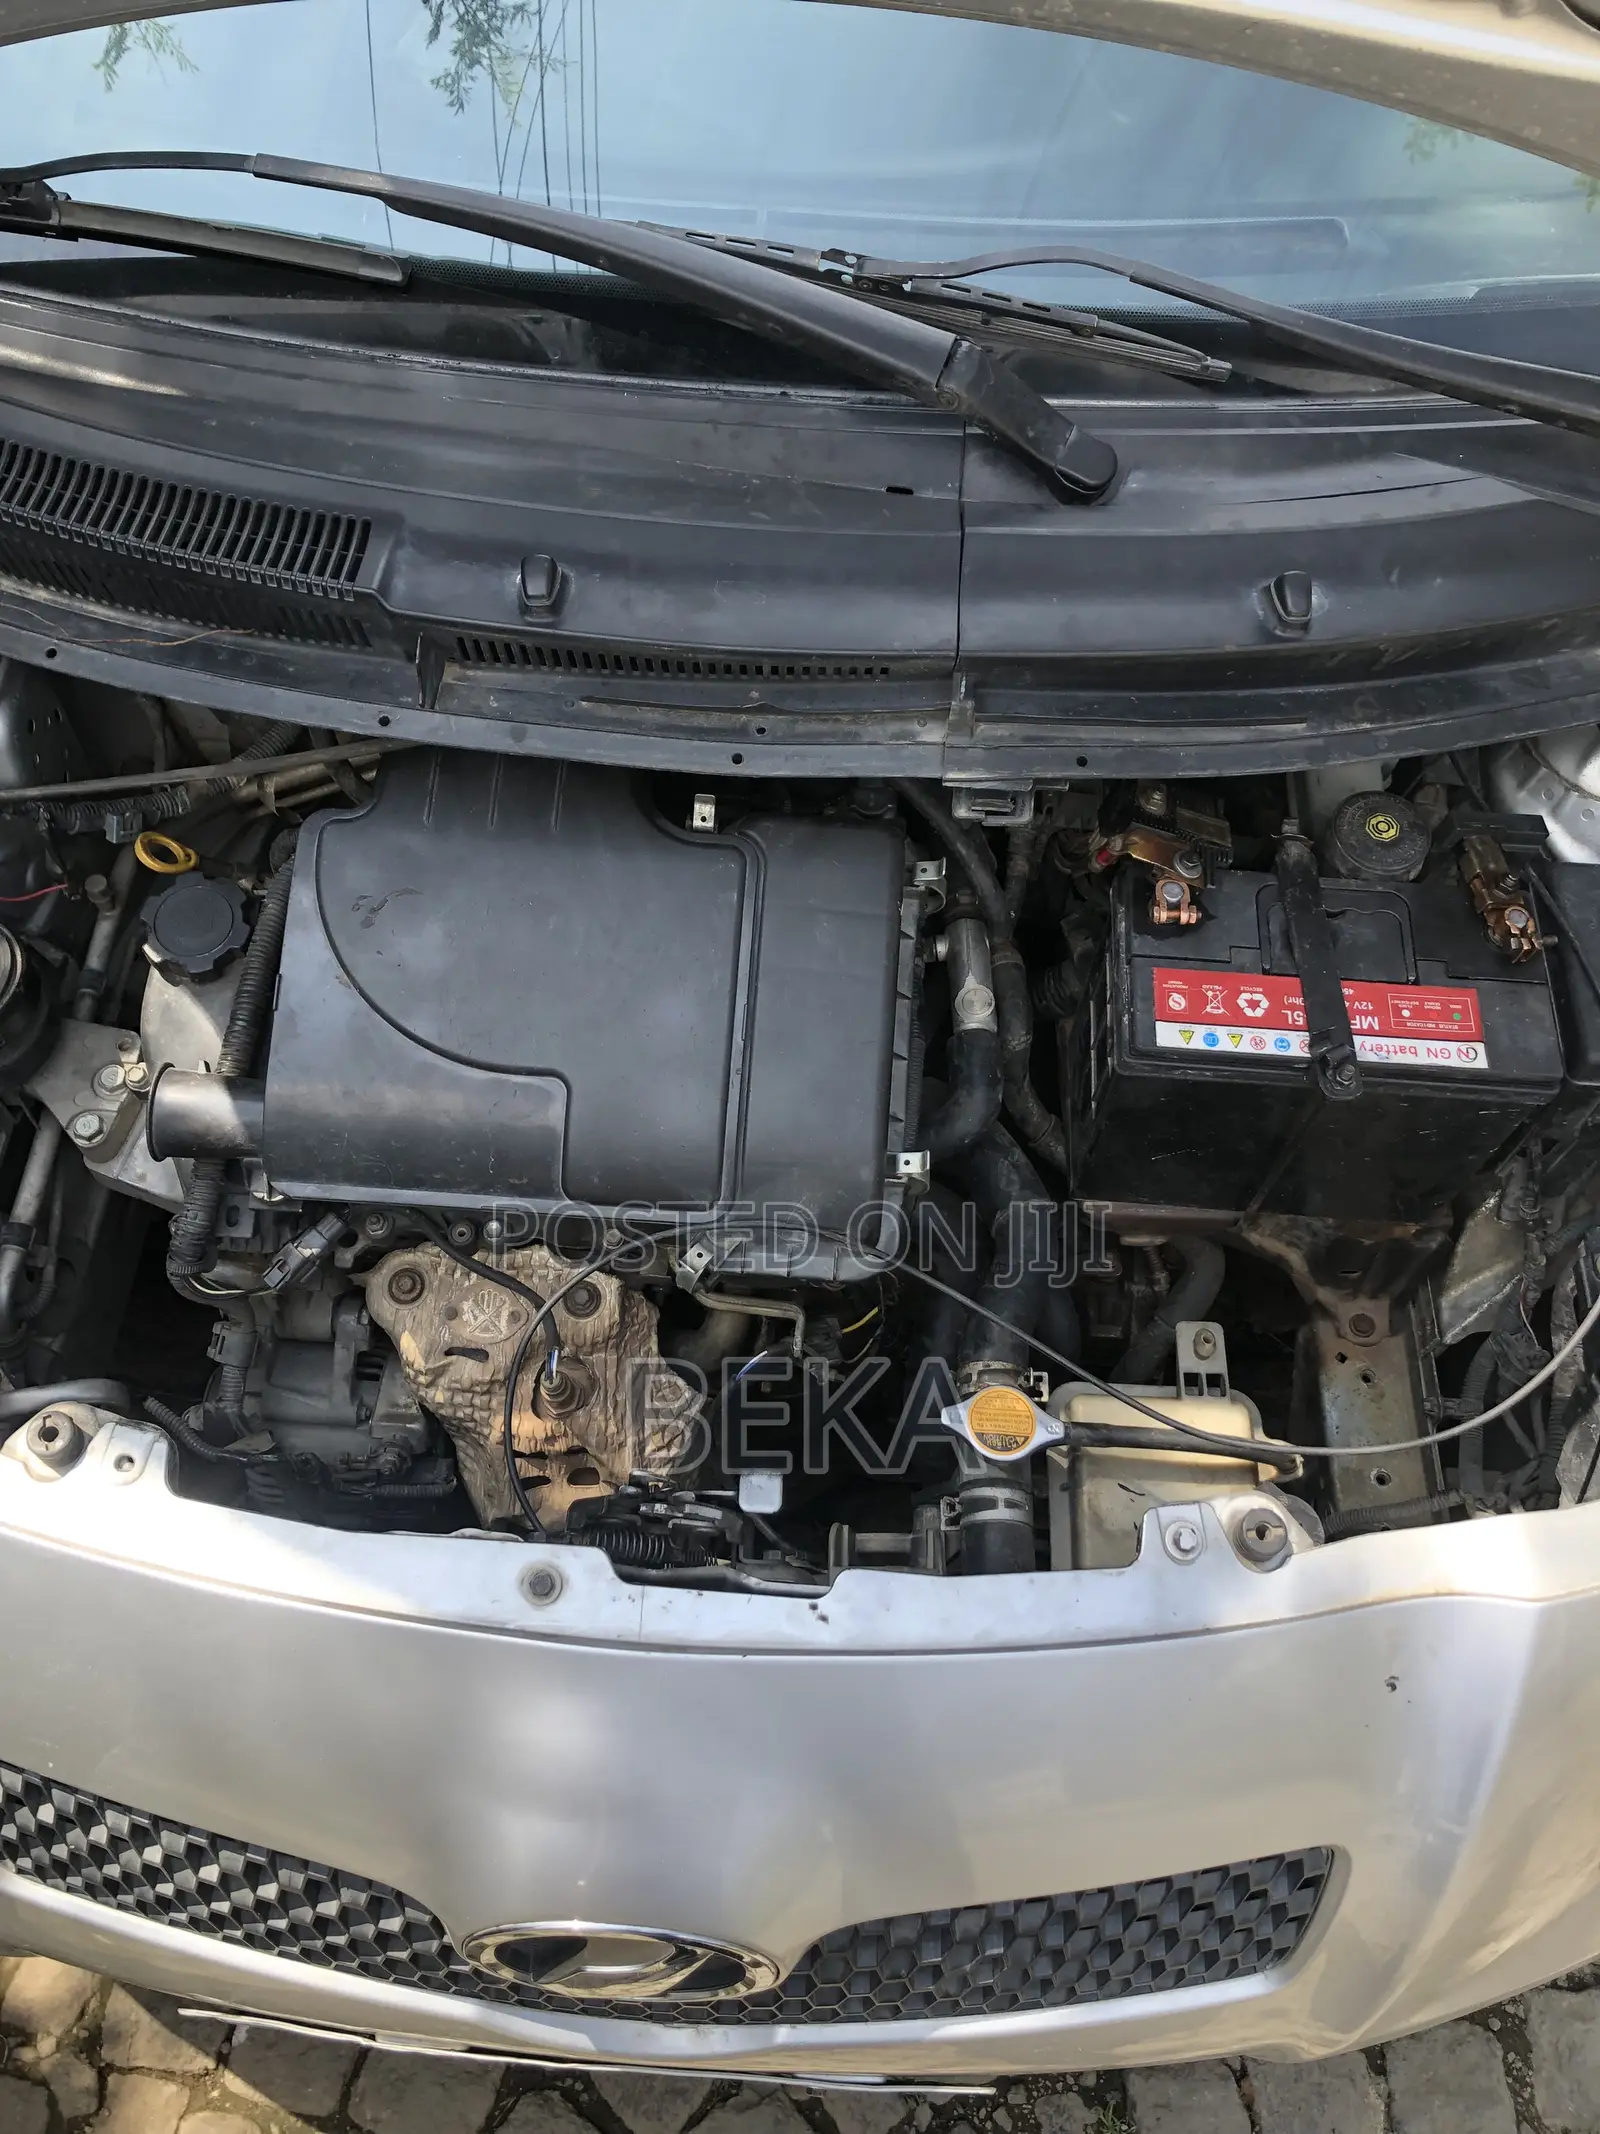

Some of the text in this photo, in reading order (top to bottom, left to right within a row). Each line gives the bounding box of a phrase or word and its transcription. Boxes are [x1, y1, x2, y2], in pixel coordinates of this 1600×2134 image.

[1353, 1001, 1373, 1010] 12V
[1350, 1015, 1379, 1030] MF
[1358, 1041, 1451, 1060] GN battery
